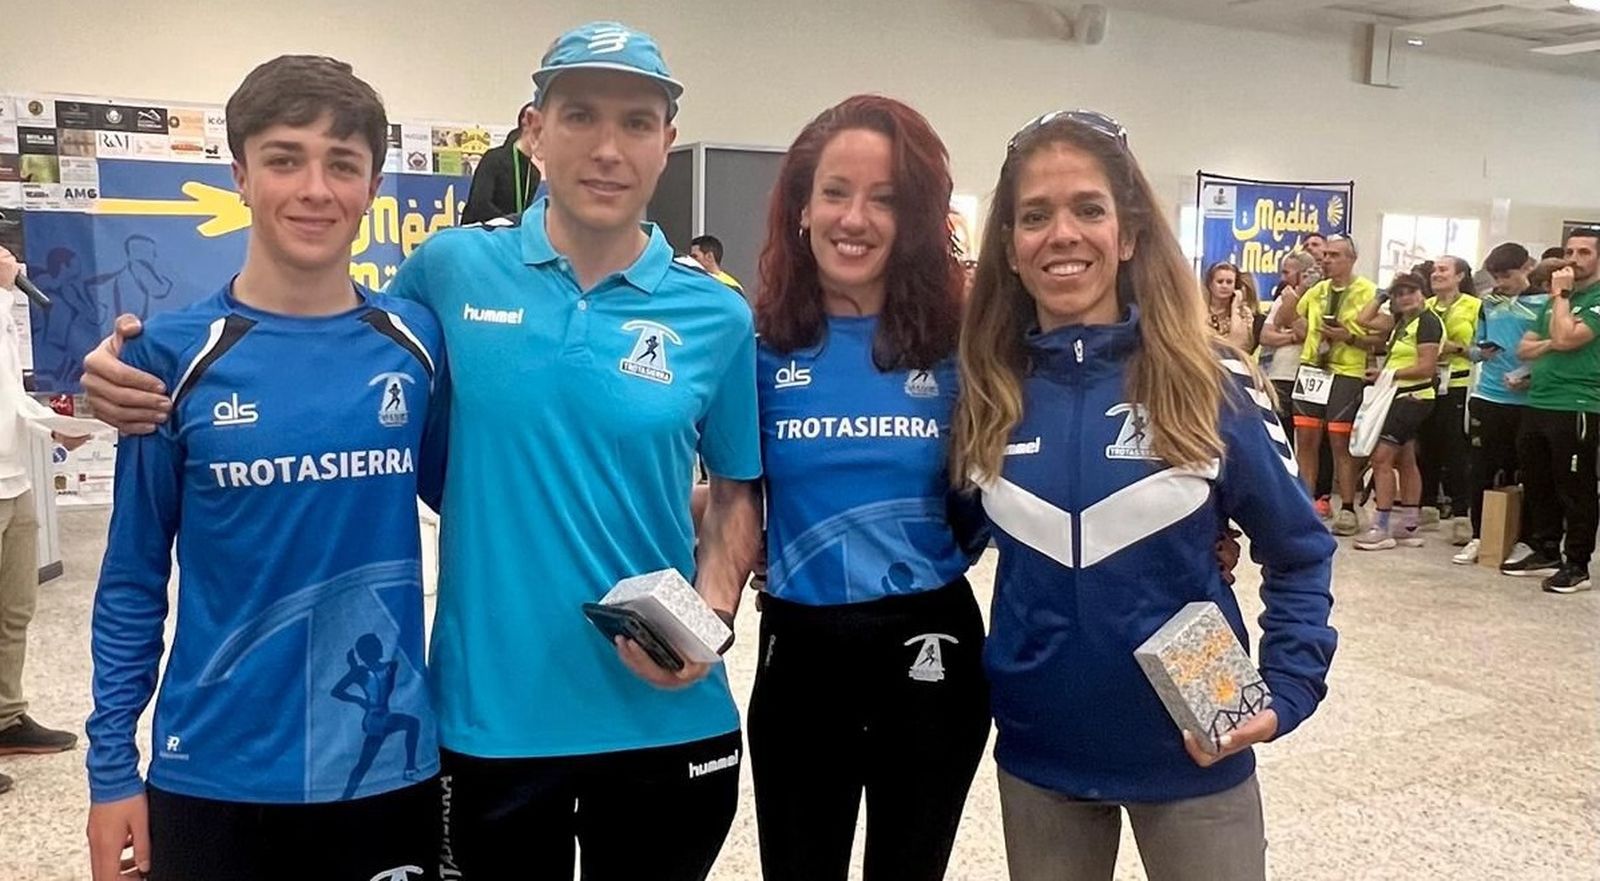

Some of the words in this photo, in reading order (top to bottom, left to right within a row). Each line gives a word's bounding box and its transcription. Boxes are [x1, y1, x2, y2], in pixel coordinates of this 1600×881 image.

[64, 187, 98, 199] AMG
[463, 303, 524, 324] hummel
[774, 360, 812, 389] als
[1304, 378, 1324, 392] 197
[213, 392, 259, 426] als
[775, 416, 940, 440] TROTASIERRA
[209, 447, 414, 488] TROTASIERRA
[689, 749, 739, 778] hummel
